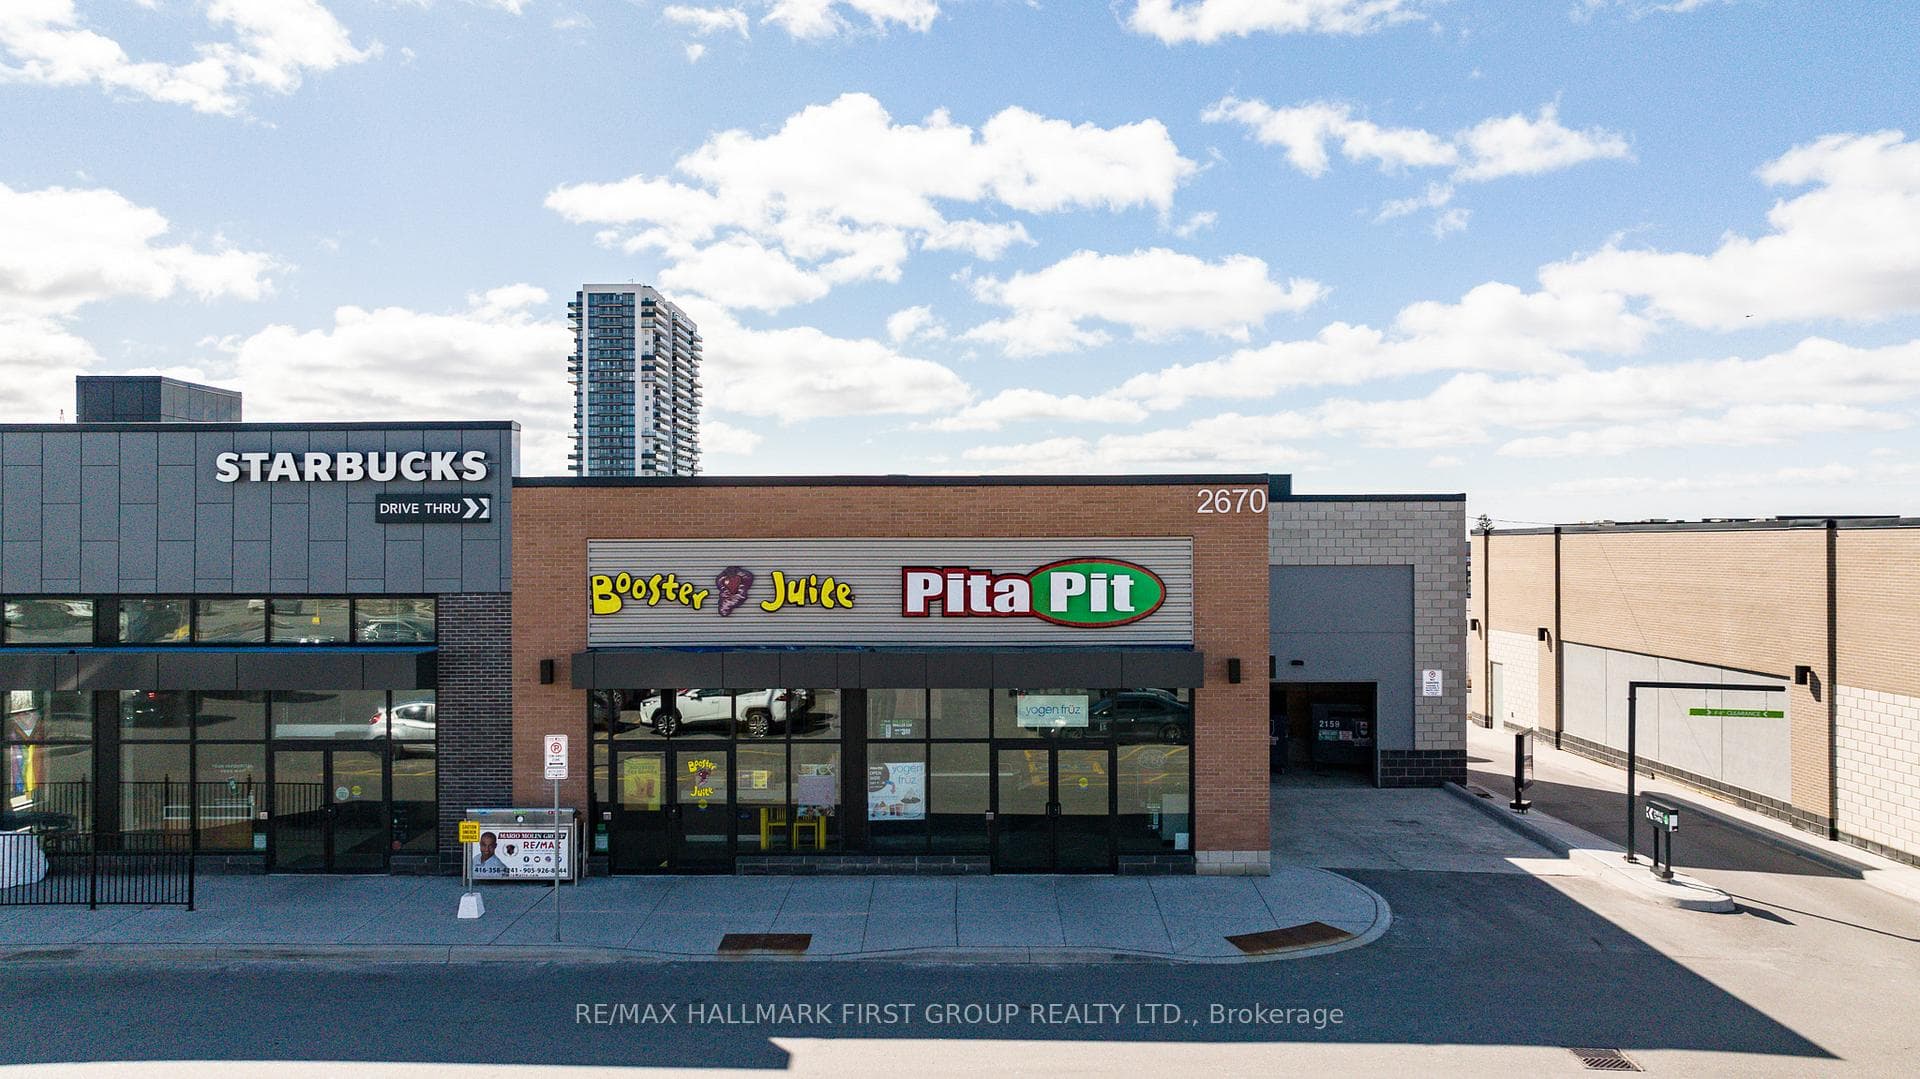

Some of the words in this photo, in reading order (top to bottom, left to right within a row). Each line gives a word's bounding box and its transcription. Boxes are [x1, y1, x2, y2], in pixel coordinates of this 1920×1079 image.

[215, 450, 487, 482] STARBUCKS
[380, 503, 419, 514] DRIVE
[424, 503, 461, 514] THRU
[1197, 489, 1266, 514] 2670
[591, 571, 709, 615] Booster
[759, 570, 854, 612] Juice
[906, 571, 1031, 613] Pita
[1050, 571, 1135, 613] Pit
[1025, 703, 1059, 716] yogen
[1061, 701, 1081, 714] früz
[1319, 720, 1340, 728] 2159
[687, 760, 716, 773] Booster
[690, 786, 713, 797] Juice
